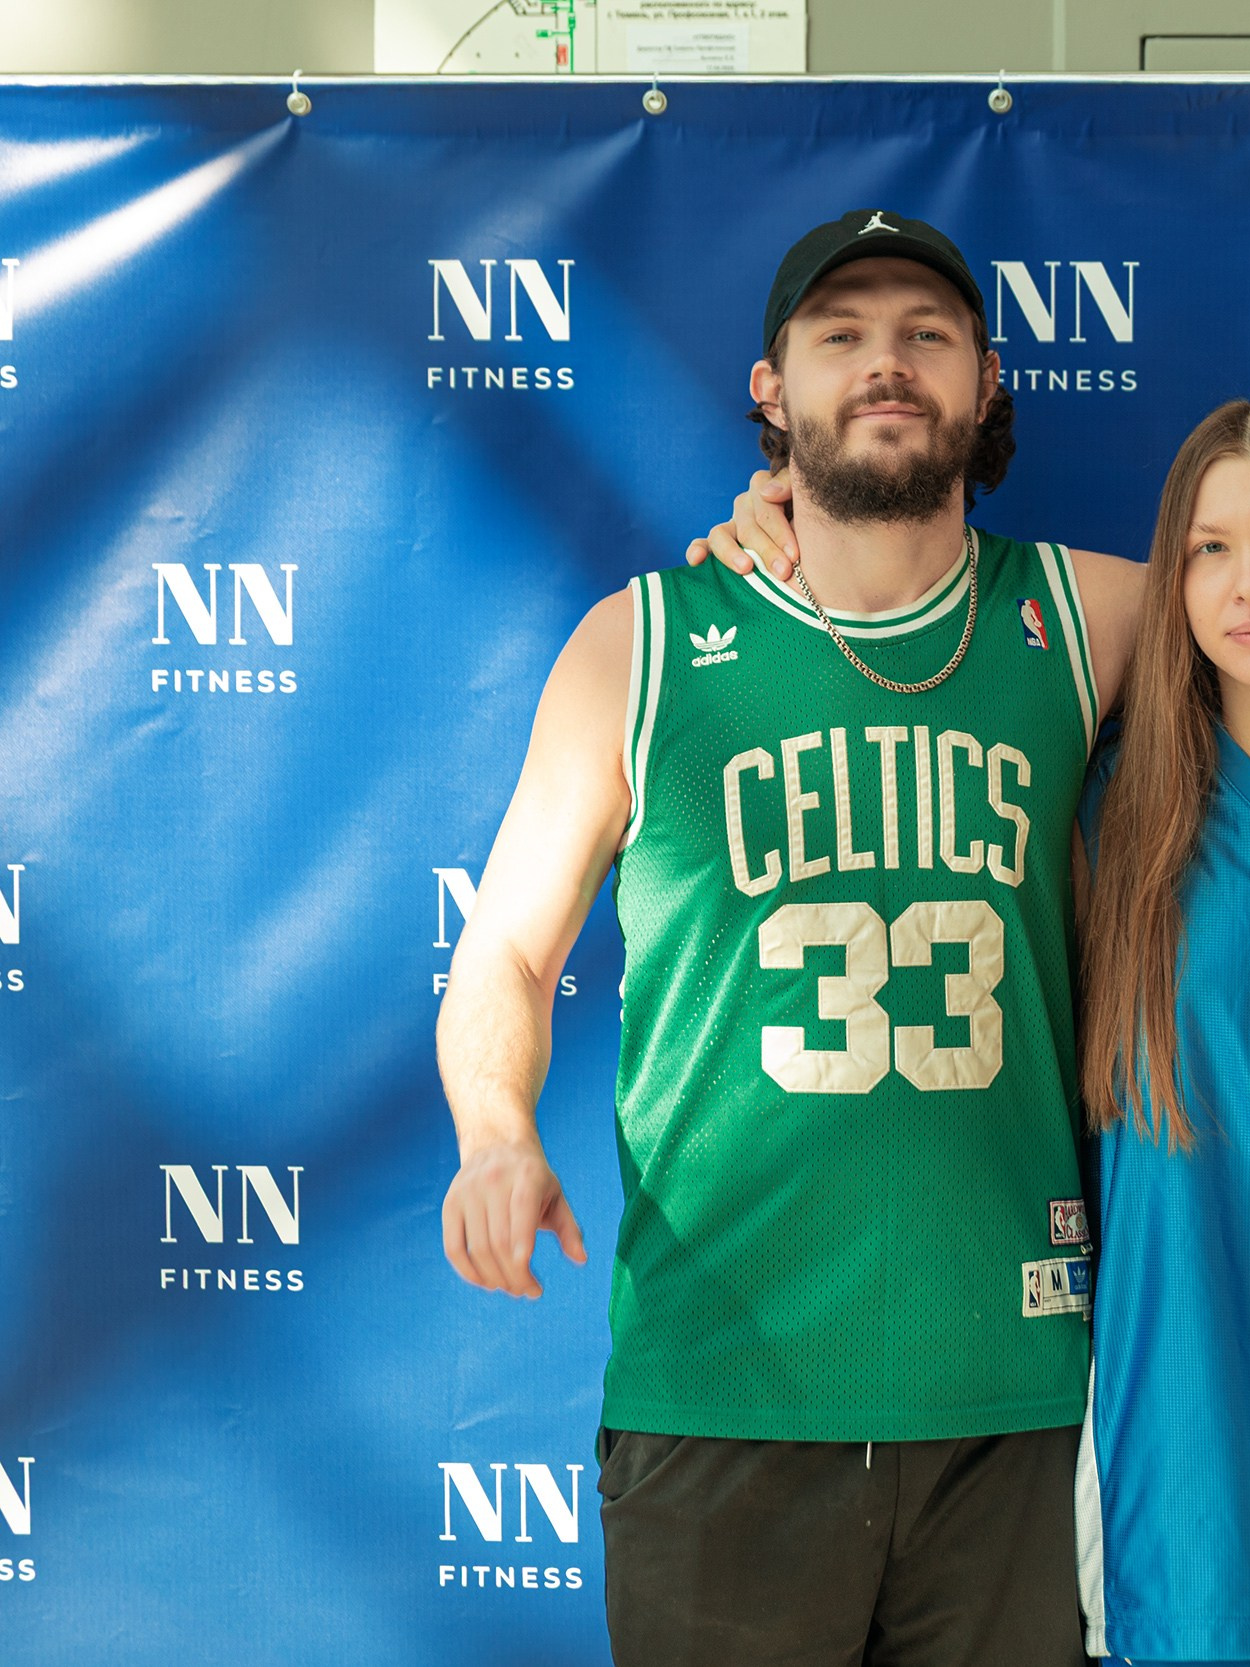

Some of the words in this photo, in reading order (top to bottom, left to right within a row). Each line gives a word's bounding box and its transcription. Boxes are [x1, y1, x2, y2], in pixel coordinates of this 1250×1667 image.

[427, 259, 575, 342] NN
[991, 261, 1140, 343] NN
[427, 367, 574, 390] FITNESS
[152, 563, 299, 646] NN
[151, 669, 297, 694] FITNESS
[691, 650, 739, 668] adidas
[723, 725, 1031, 897] CELTICS
[758, 900, 1005, 1095] 33
[159, 1164, 304, 1245] NN
[160, 1268, 304, 1292] FITNESS
[1051, 1269, 1063, 1291] M
[438, 1462, 585, 1542] NN
[439, 1565, 584, 1589] FITNESS
